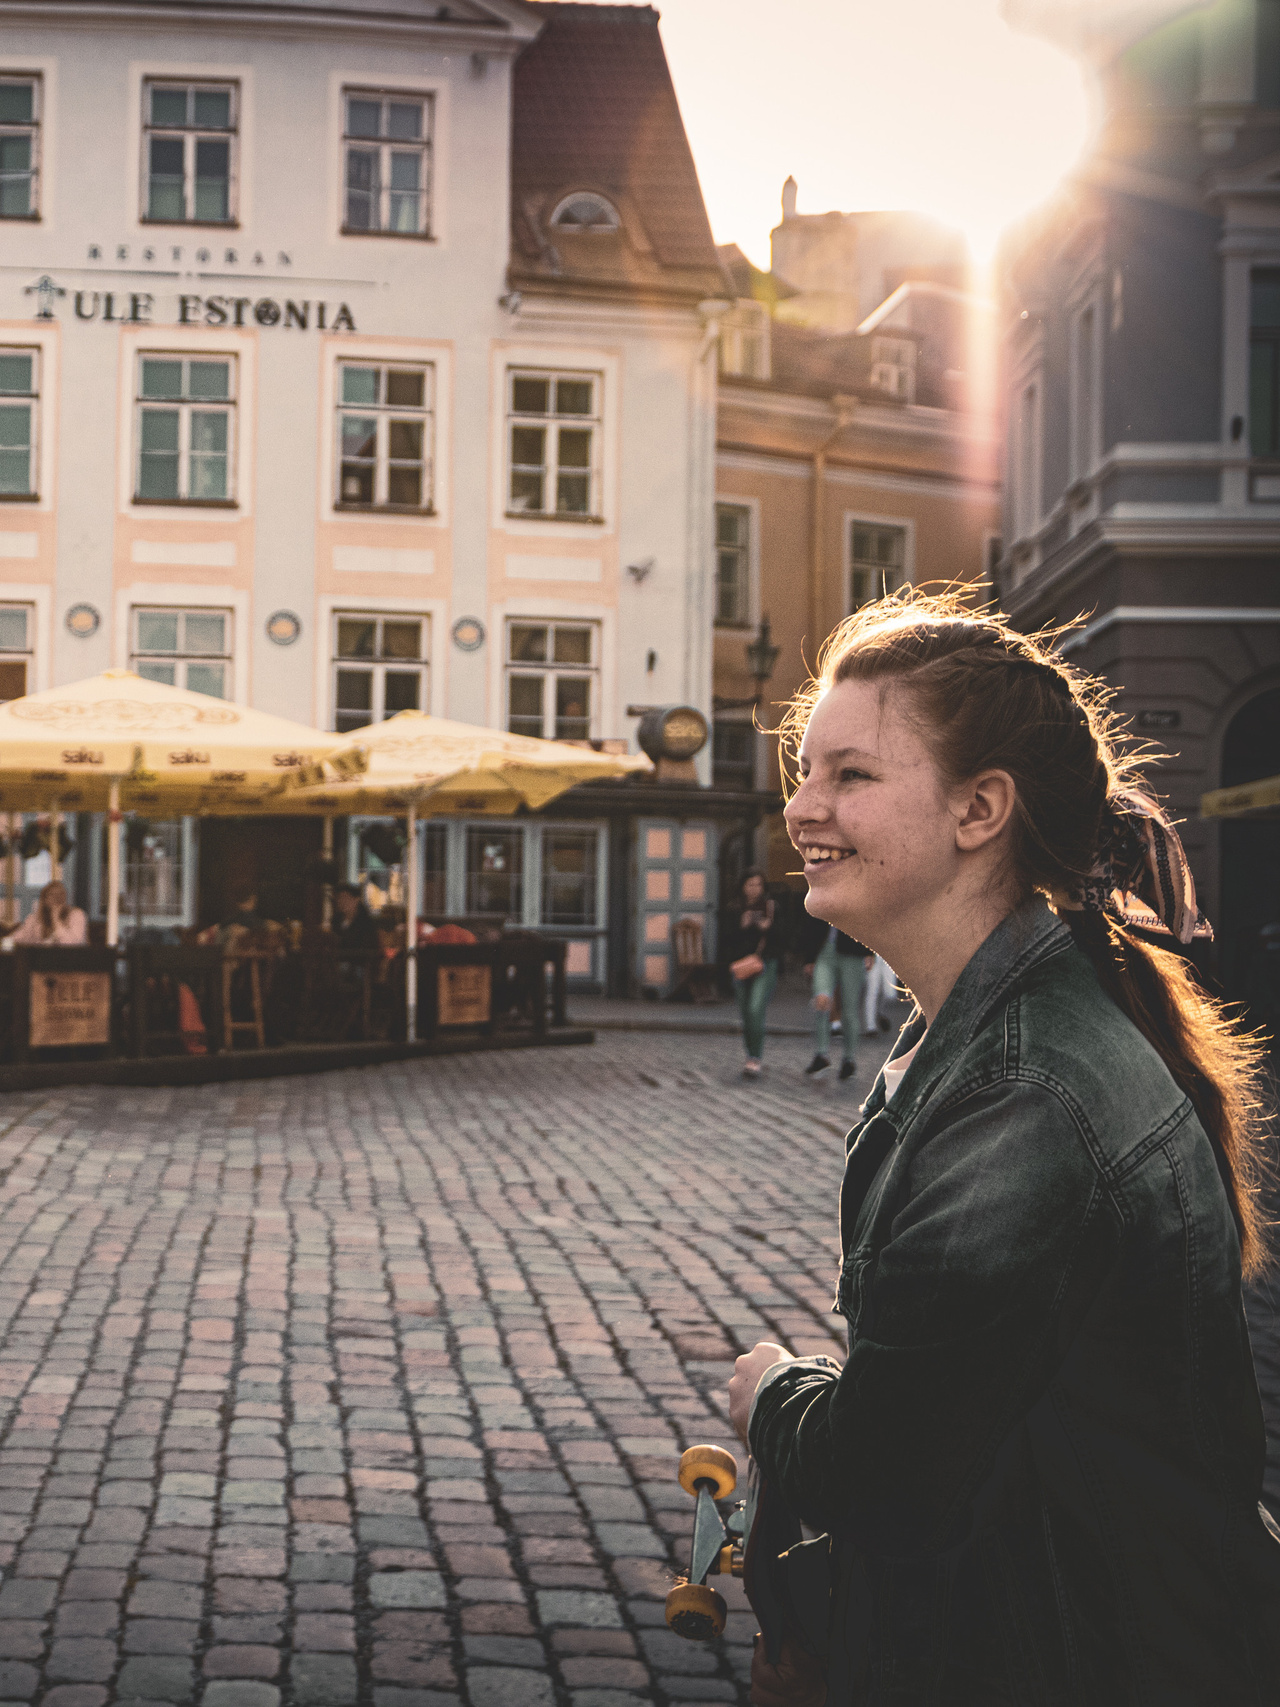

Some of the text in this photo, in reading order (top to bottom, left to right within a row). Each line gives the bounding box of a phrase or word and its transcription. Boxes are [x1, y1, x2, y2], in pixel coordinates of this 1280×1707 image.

[87, 243, 294, 266] RESTORAN
[179, 293, 357, 332] ESTONIA
[62, 746, 104, 764] saku
[169, 748, 210, 765] saku
